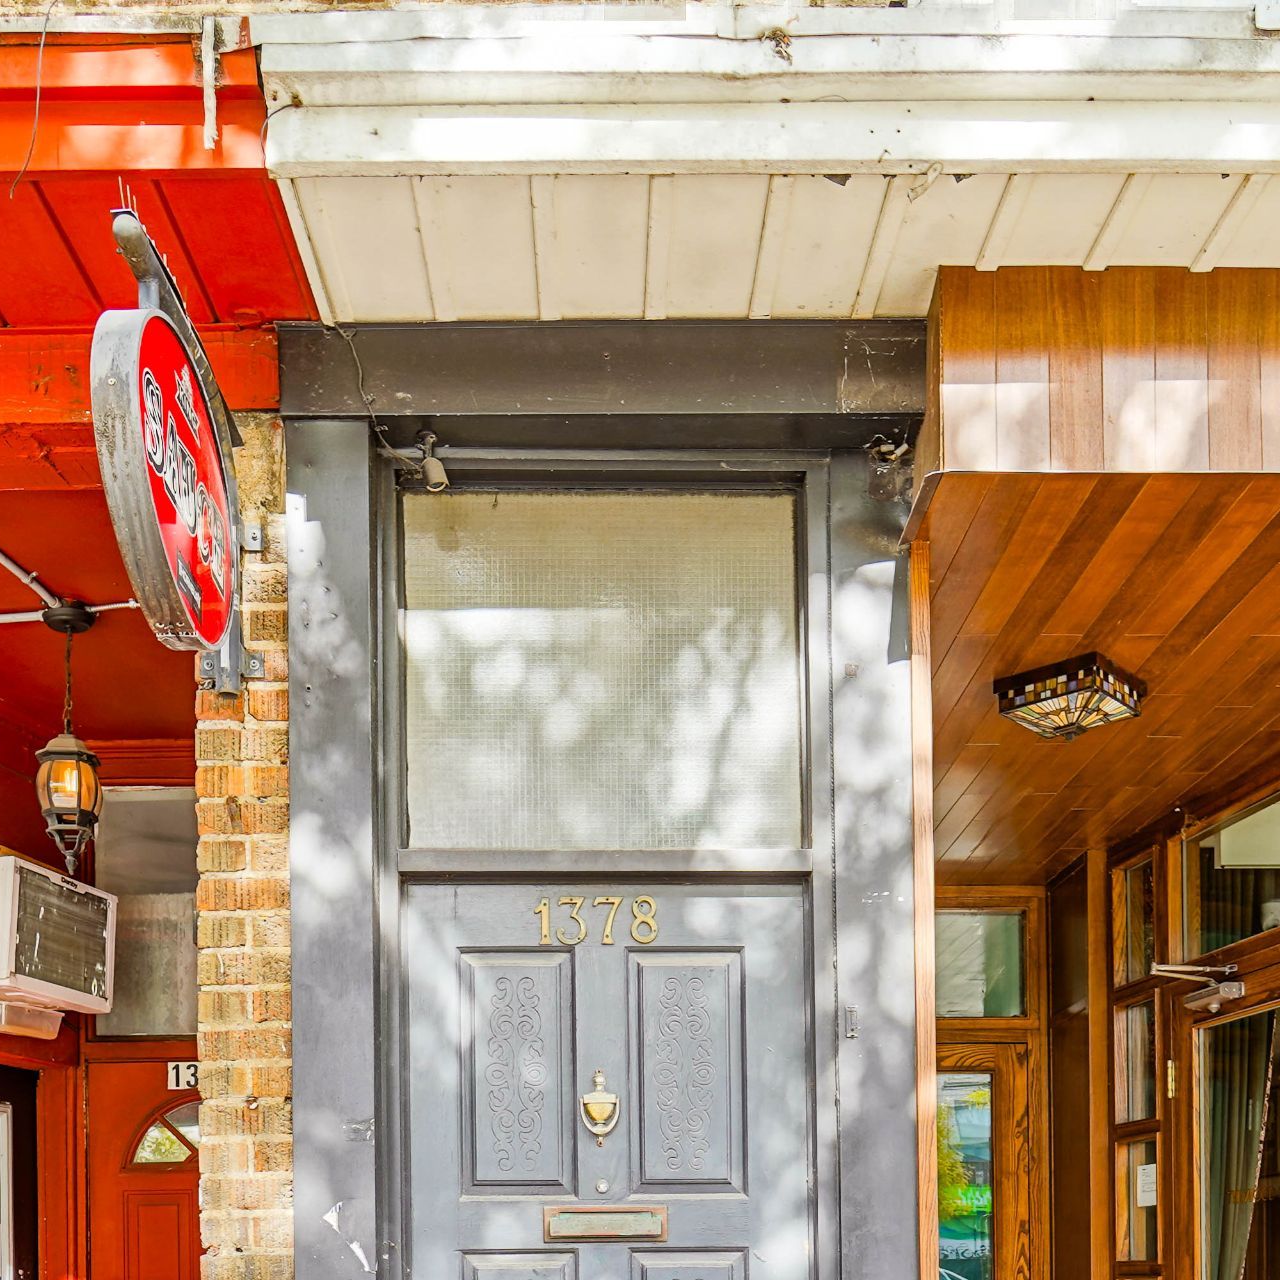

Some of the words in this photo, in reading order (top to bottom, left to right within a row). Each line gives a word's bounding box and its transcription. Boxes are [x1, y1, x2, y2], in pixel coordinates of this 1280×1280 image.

[142, 366, 225, 602] SAUCE
[534, 895, 659, 945] 1378
[172, 1063, 199, 1088] 13
